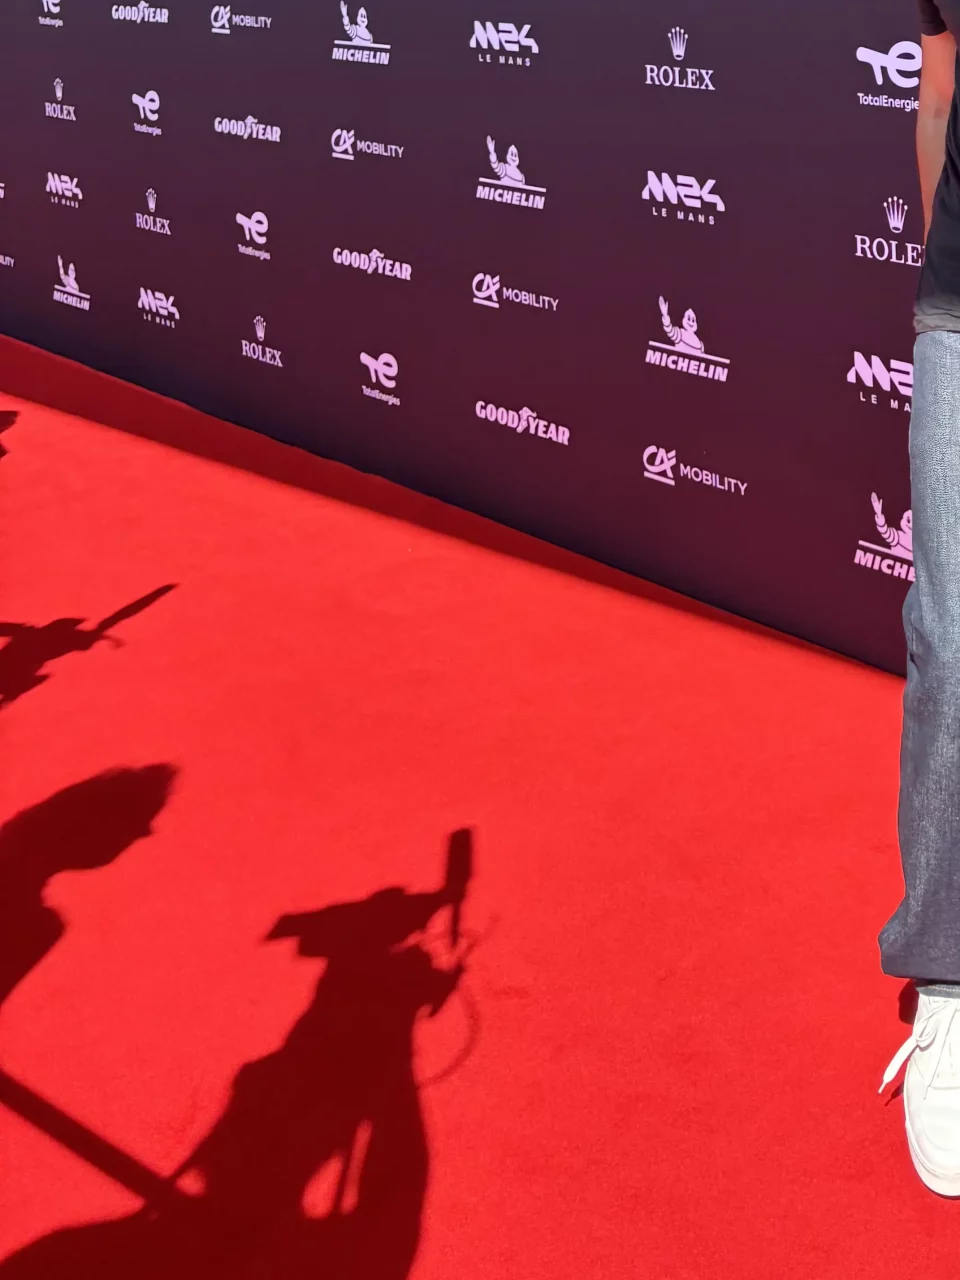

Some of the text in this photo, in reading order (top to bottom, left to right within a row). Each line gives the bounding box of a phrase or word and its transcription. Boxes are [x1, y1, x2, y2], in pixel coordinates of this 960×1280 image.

[112, 1, 168, 23] GOODYEAR
[232, 15, 271, 28] MOBILITY
[332, 48, 389, 64] MICHELIN
[479, 54, 530, 66] LE MANS
[645, 65, 715, 90] ROLEX
[45, 102, 76, 121] ROLEX
[857, 92, 920, 113] TotalEnergie
[214, 115, 281, 142] GOODYEAR
[357, 140, 404, 158] MOBILITY
[476, 185, 545, 210] MICHELIN
[136, 213, 171, 235] ROLEX
[653, 207, 714, 224] LE MANS
[854, 234, 925, 267] ROLE
[333, 248, 411, 280] GOODYEAR
[53, 290, 90, 310] MICHELIN
[503, 287, 558, 311] MOBILITY
[242, 340, 283, 367] ROLEX
[645, 349, 728, 382] MICHELIN
[859, 391, 912, 413] LE MA
[476, 401, 569, 445] GOODYEAR
[680, 463, 747, 495] MOBILITY
[853, 549, 916, 582] MICHE
